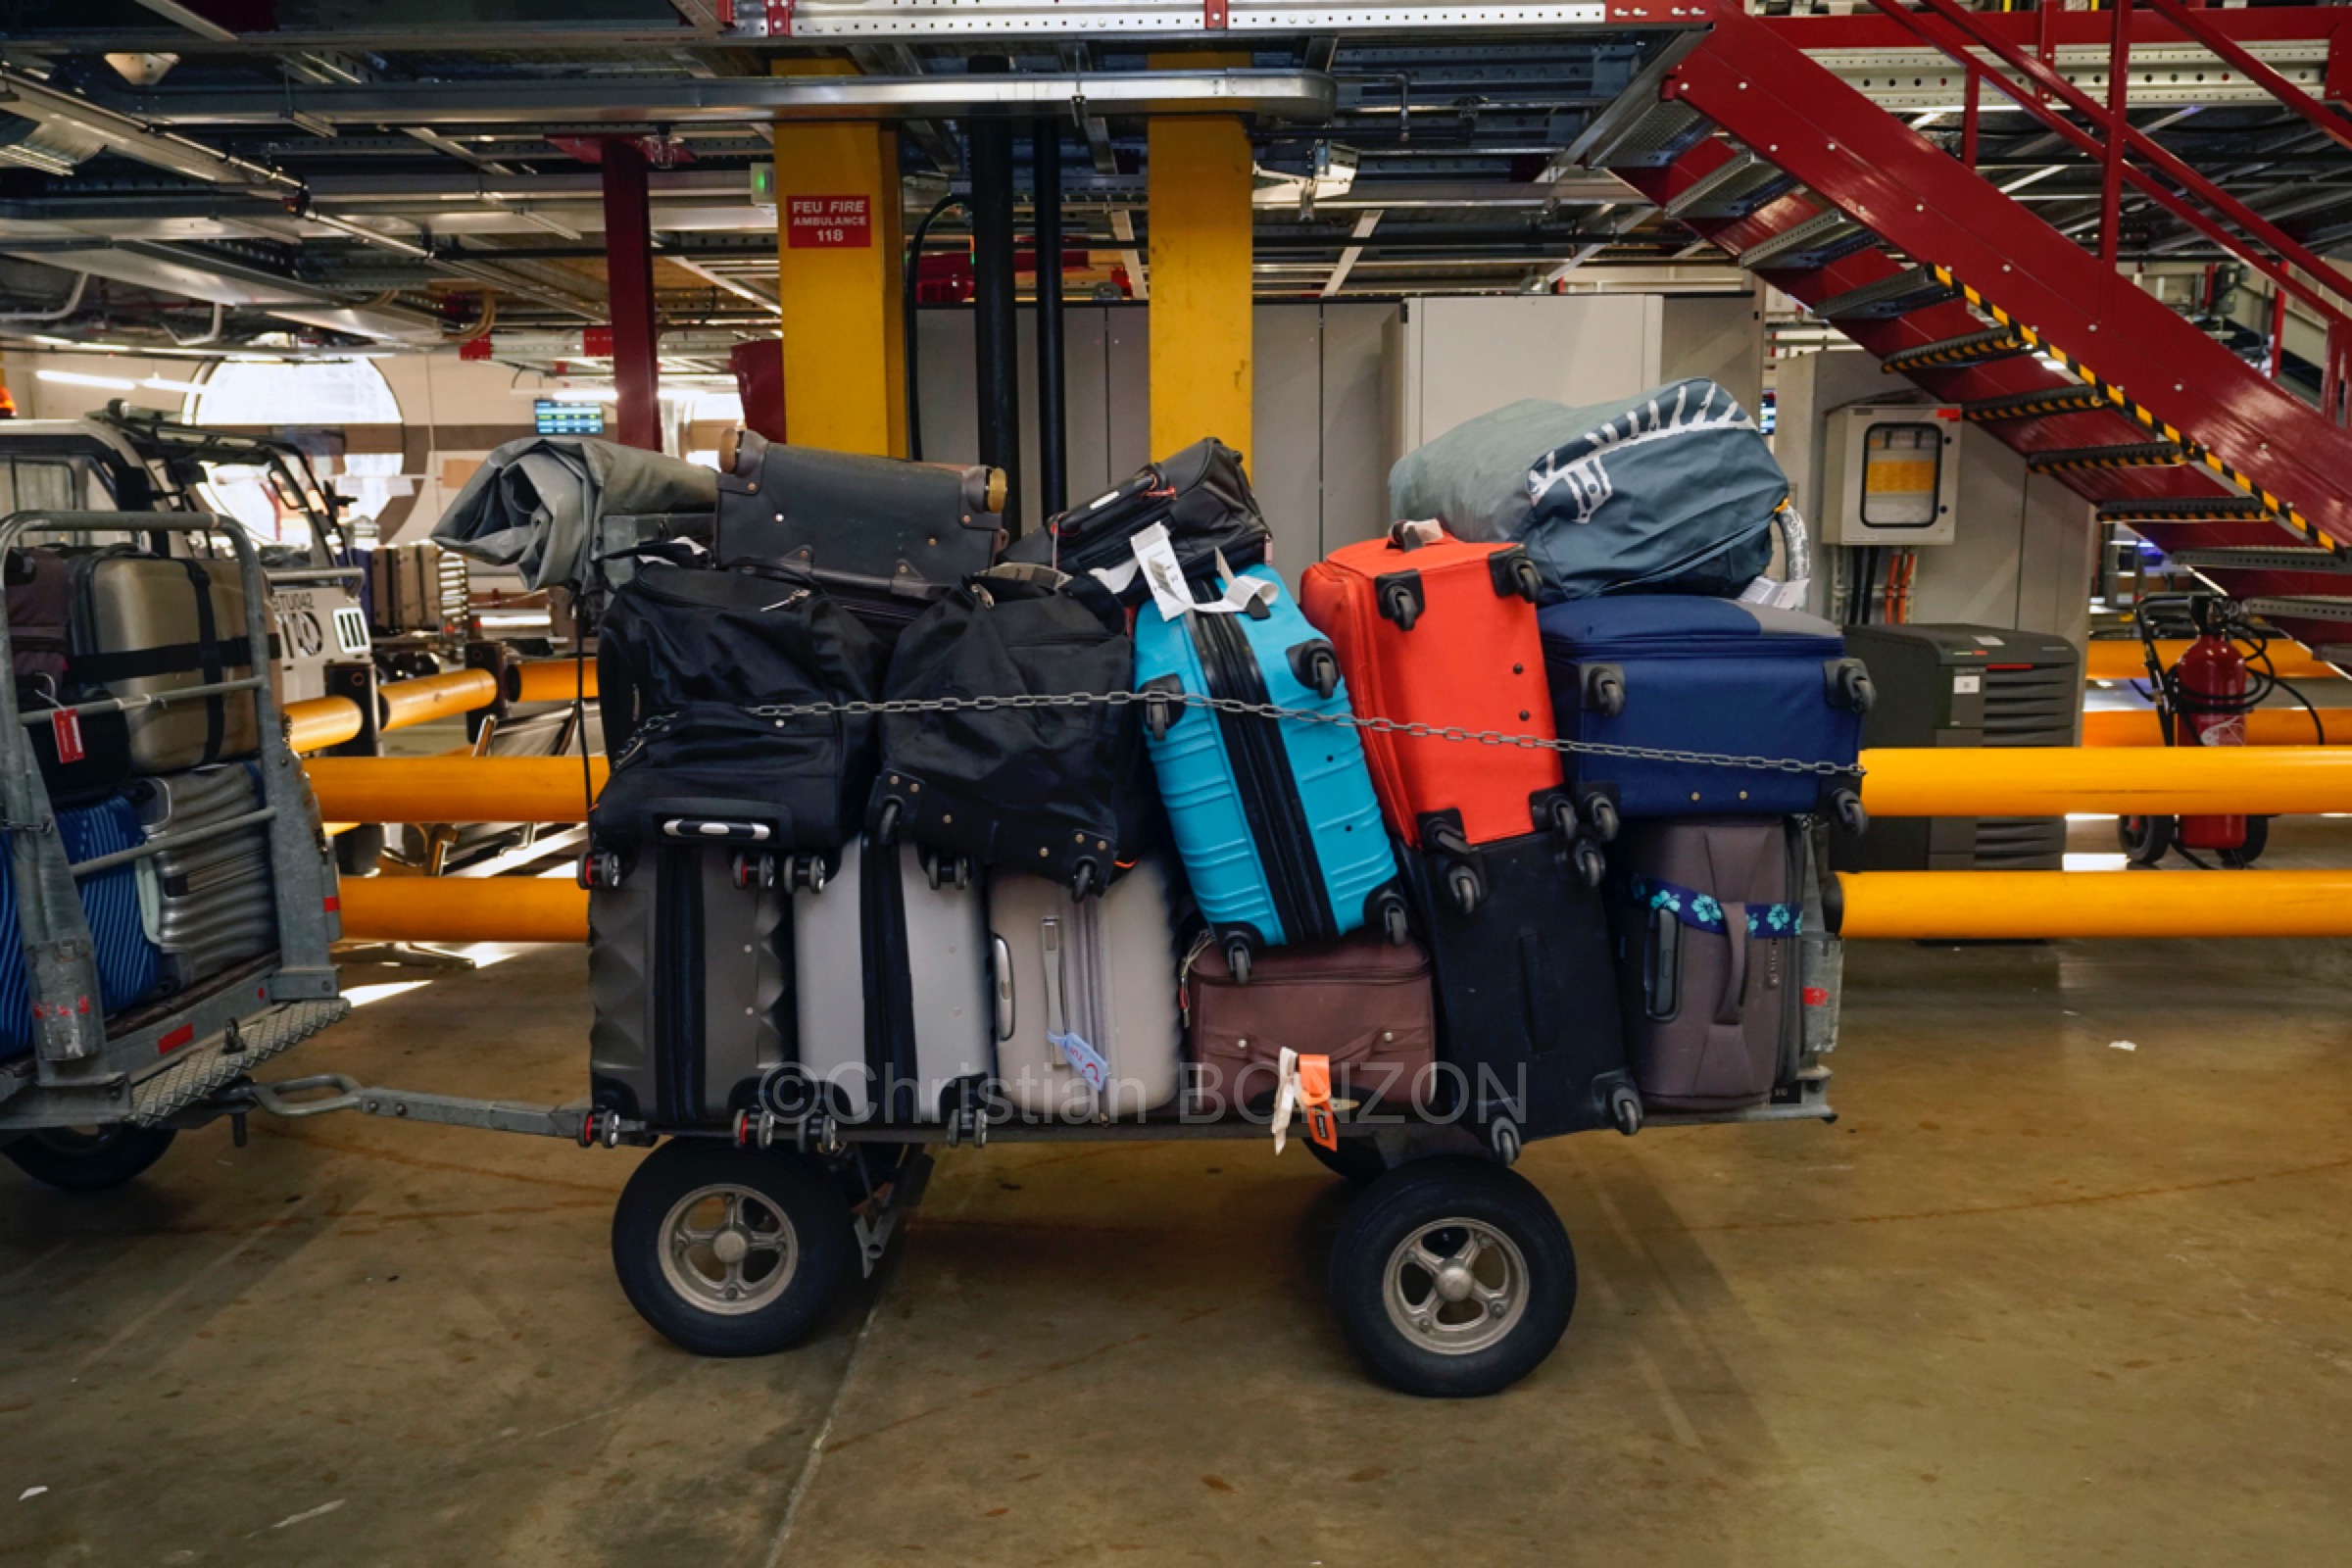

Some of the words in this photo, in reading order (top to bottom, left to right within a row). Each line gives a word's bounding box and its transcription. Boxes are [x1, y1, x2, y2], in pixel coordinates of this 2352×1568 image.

[793, 201, 822, 214] FEU
[829, 200, 865, 214] FIRE
[793, 216, 867, 226] AMBULANCE
[816, 228, 844, 242] 118
